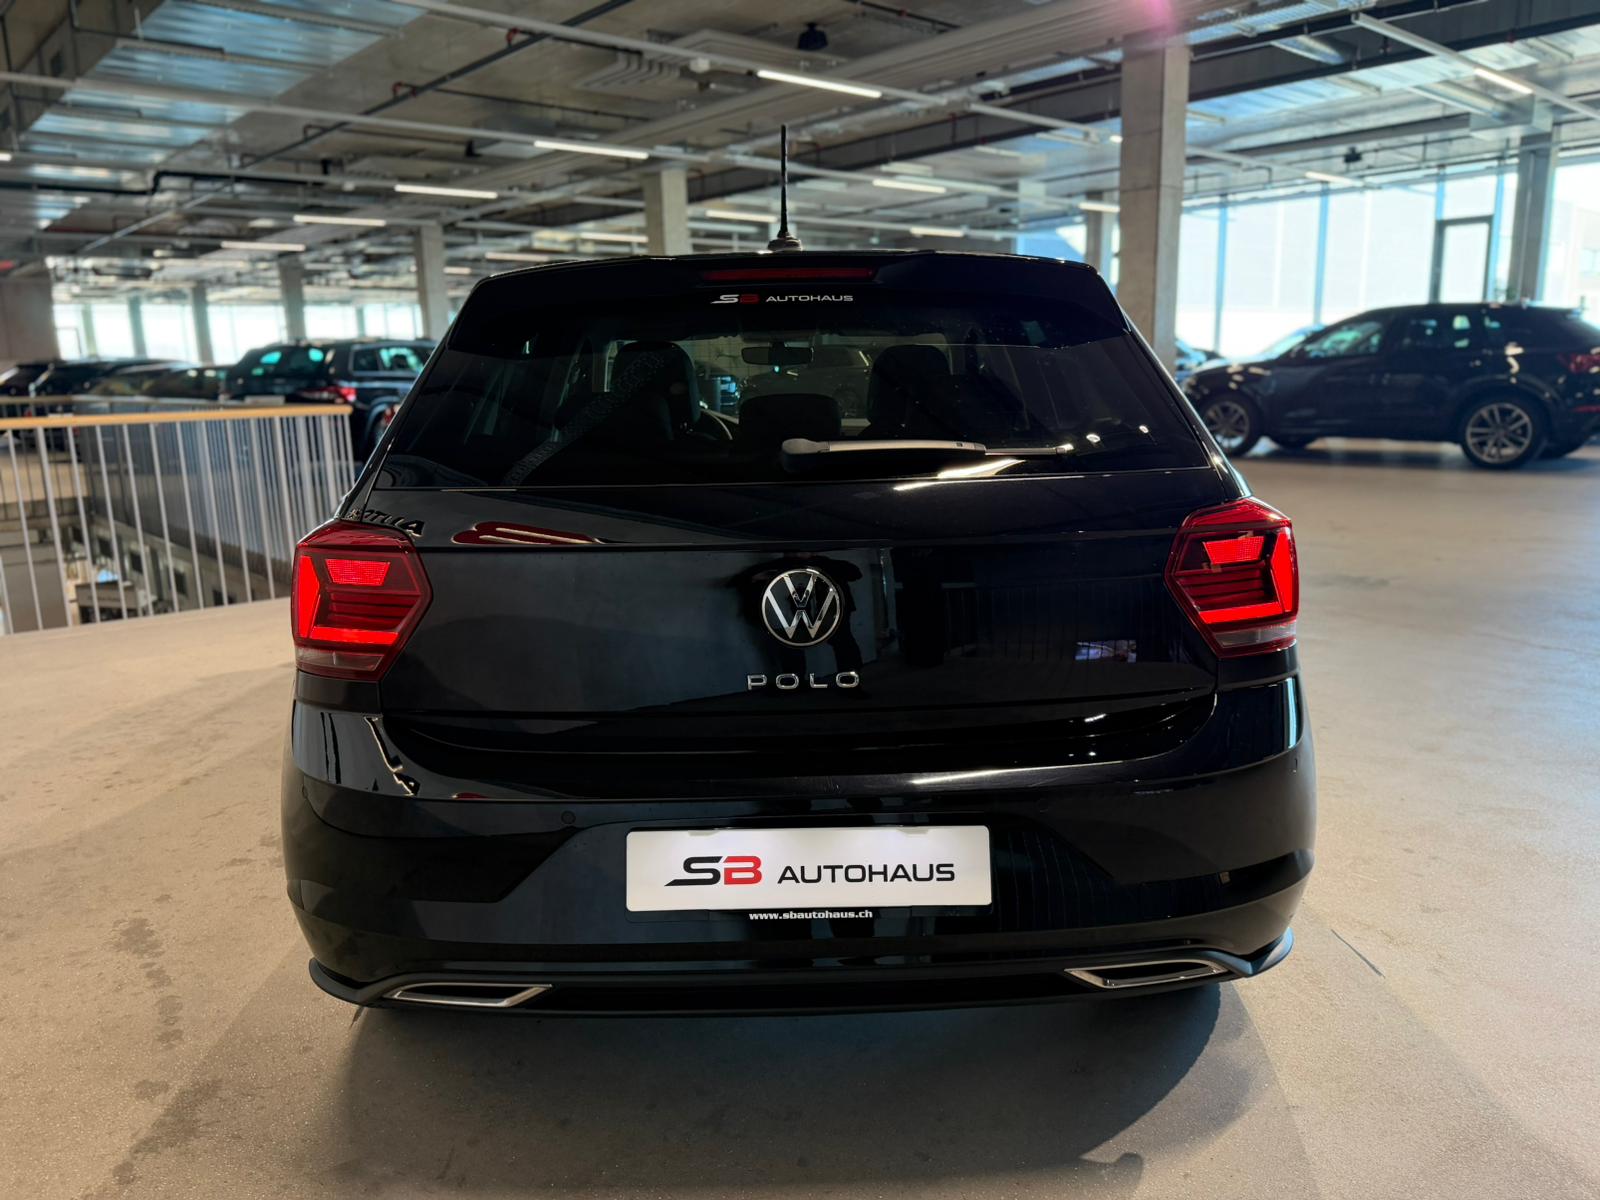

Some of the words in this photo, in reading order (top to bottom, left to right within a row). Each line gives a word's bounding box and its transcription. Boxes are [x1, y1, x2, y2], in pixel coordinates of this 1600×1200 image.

[765, 294, 855, 303] AUTOHAUS
[747, 671, 860, 690] POLO
[664, 855, 763, 886] SB
[777, 863, 956, 884] AUTOHAUS
[748, 909, 873, 921] www.sbautohaus.ch
